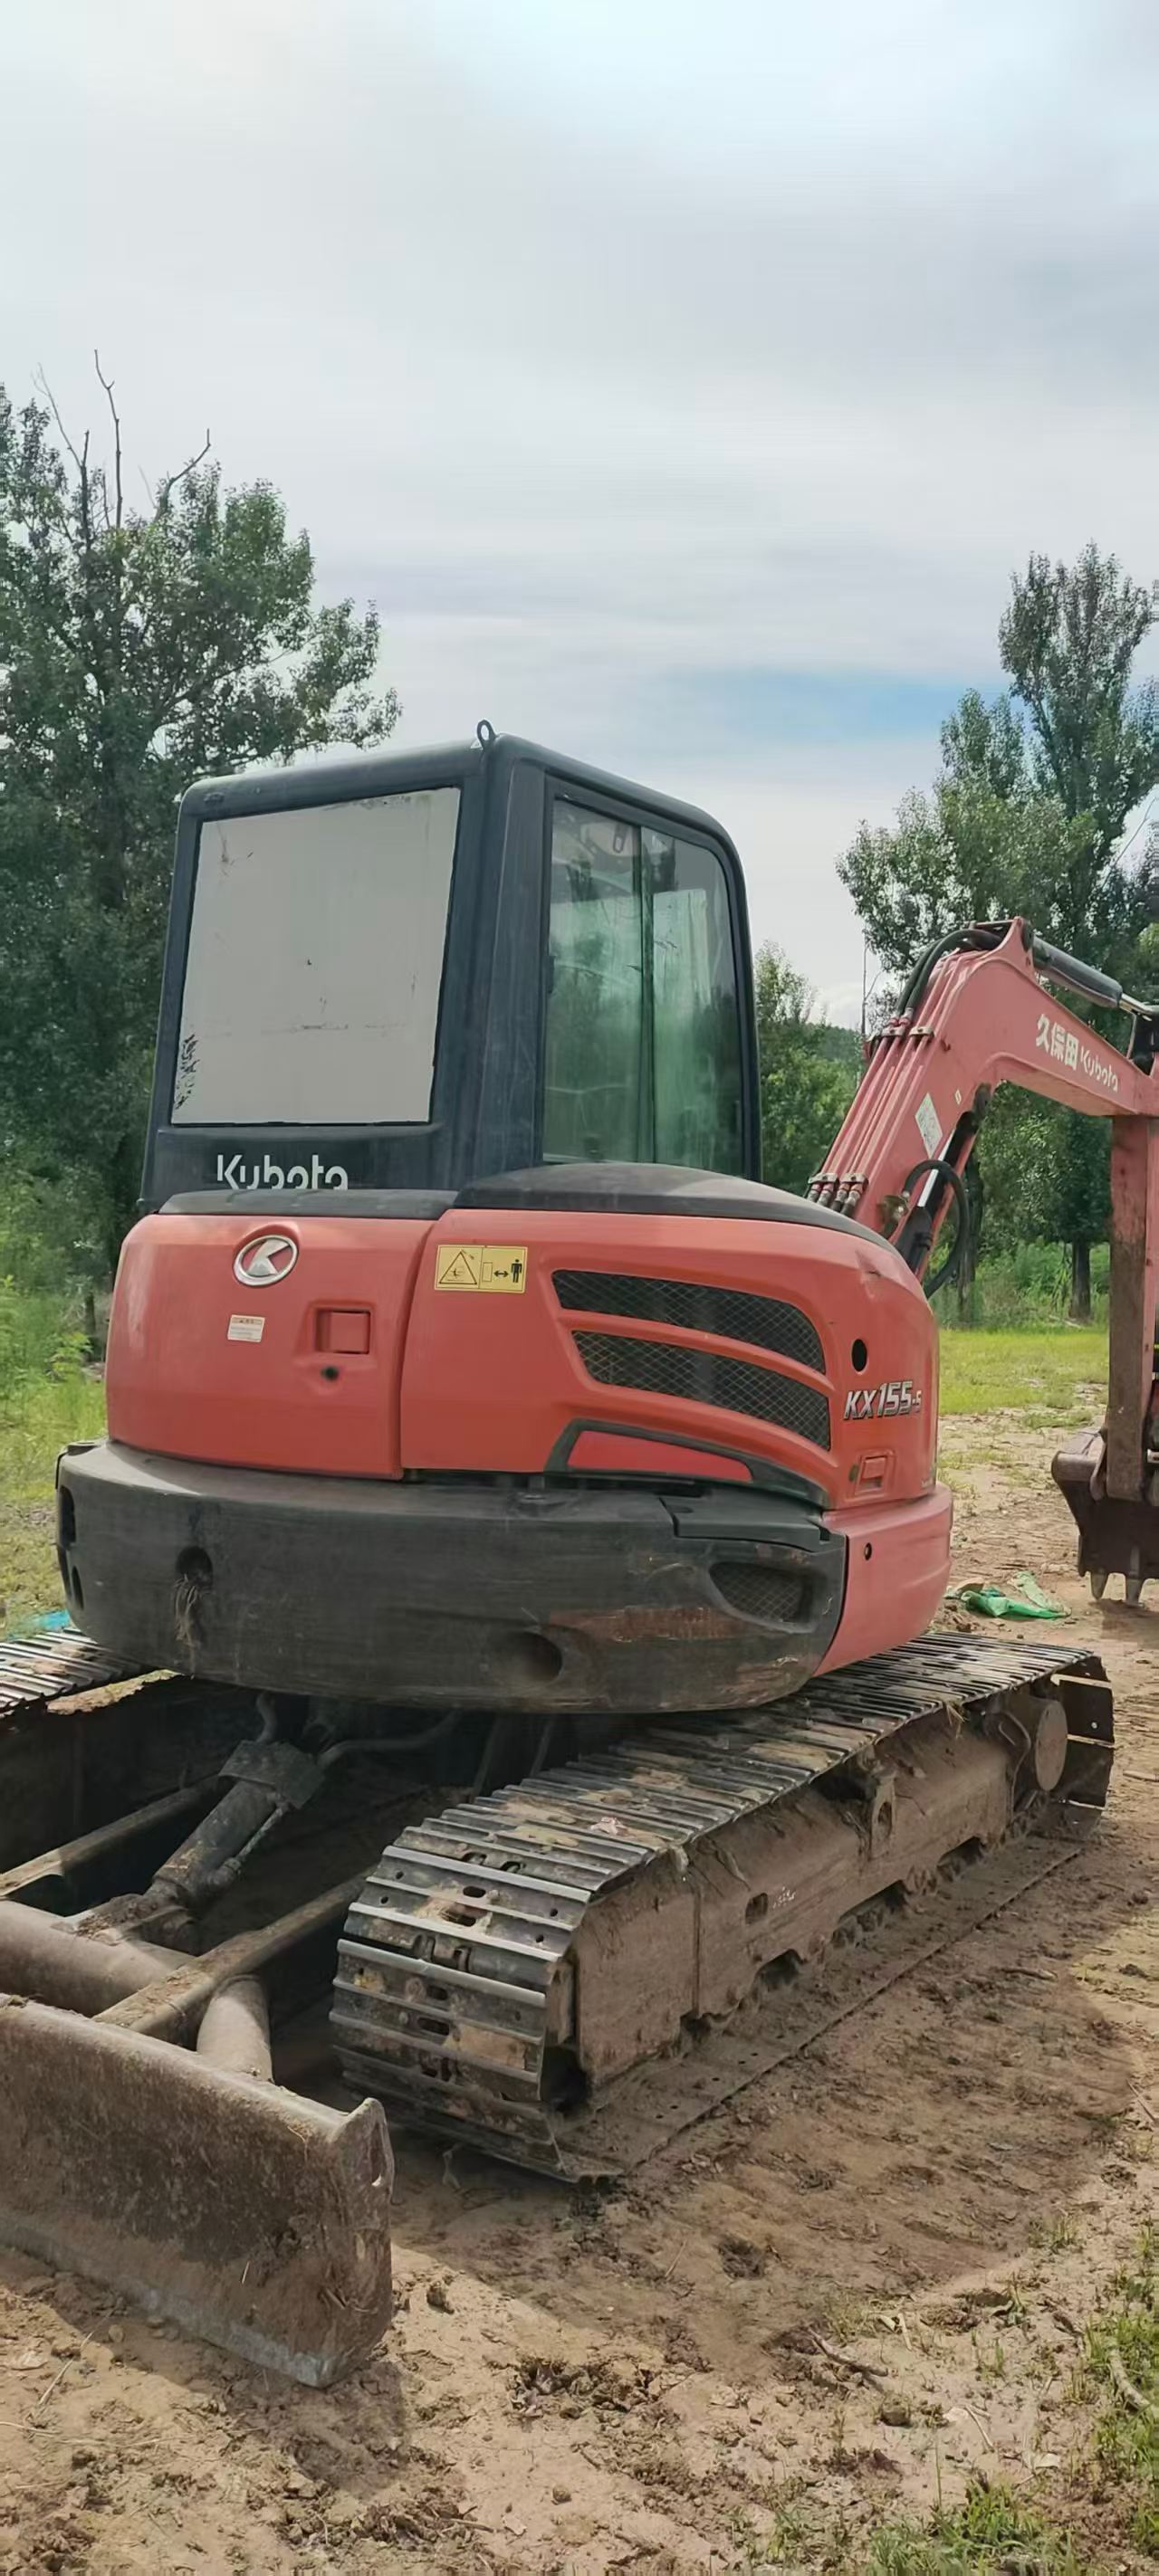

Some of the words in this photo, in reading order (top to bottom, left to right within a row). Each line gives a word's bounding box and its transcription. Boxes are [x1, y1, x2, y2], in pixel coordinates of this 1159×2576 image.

[1036, 1014, 1079, 1071] 久保田
[1080, 1045, 1119, 1092] Kubota
[216, 1154, 349, 1190] Kubota
